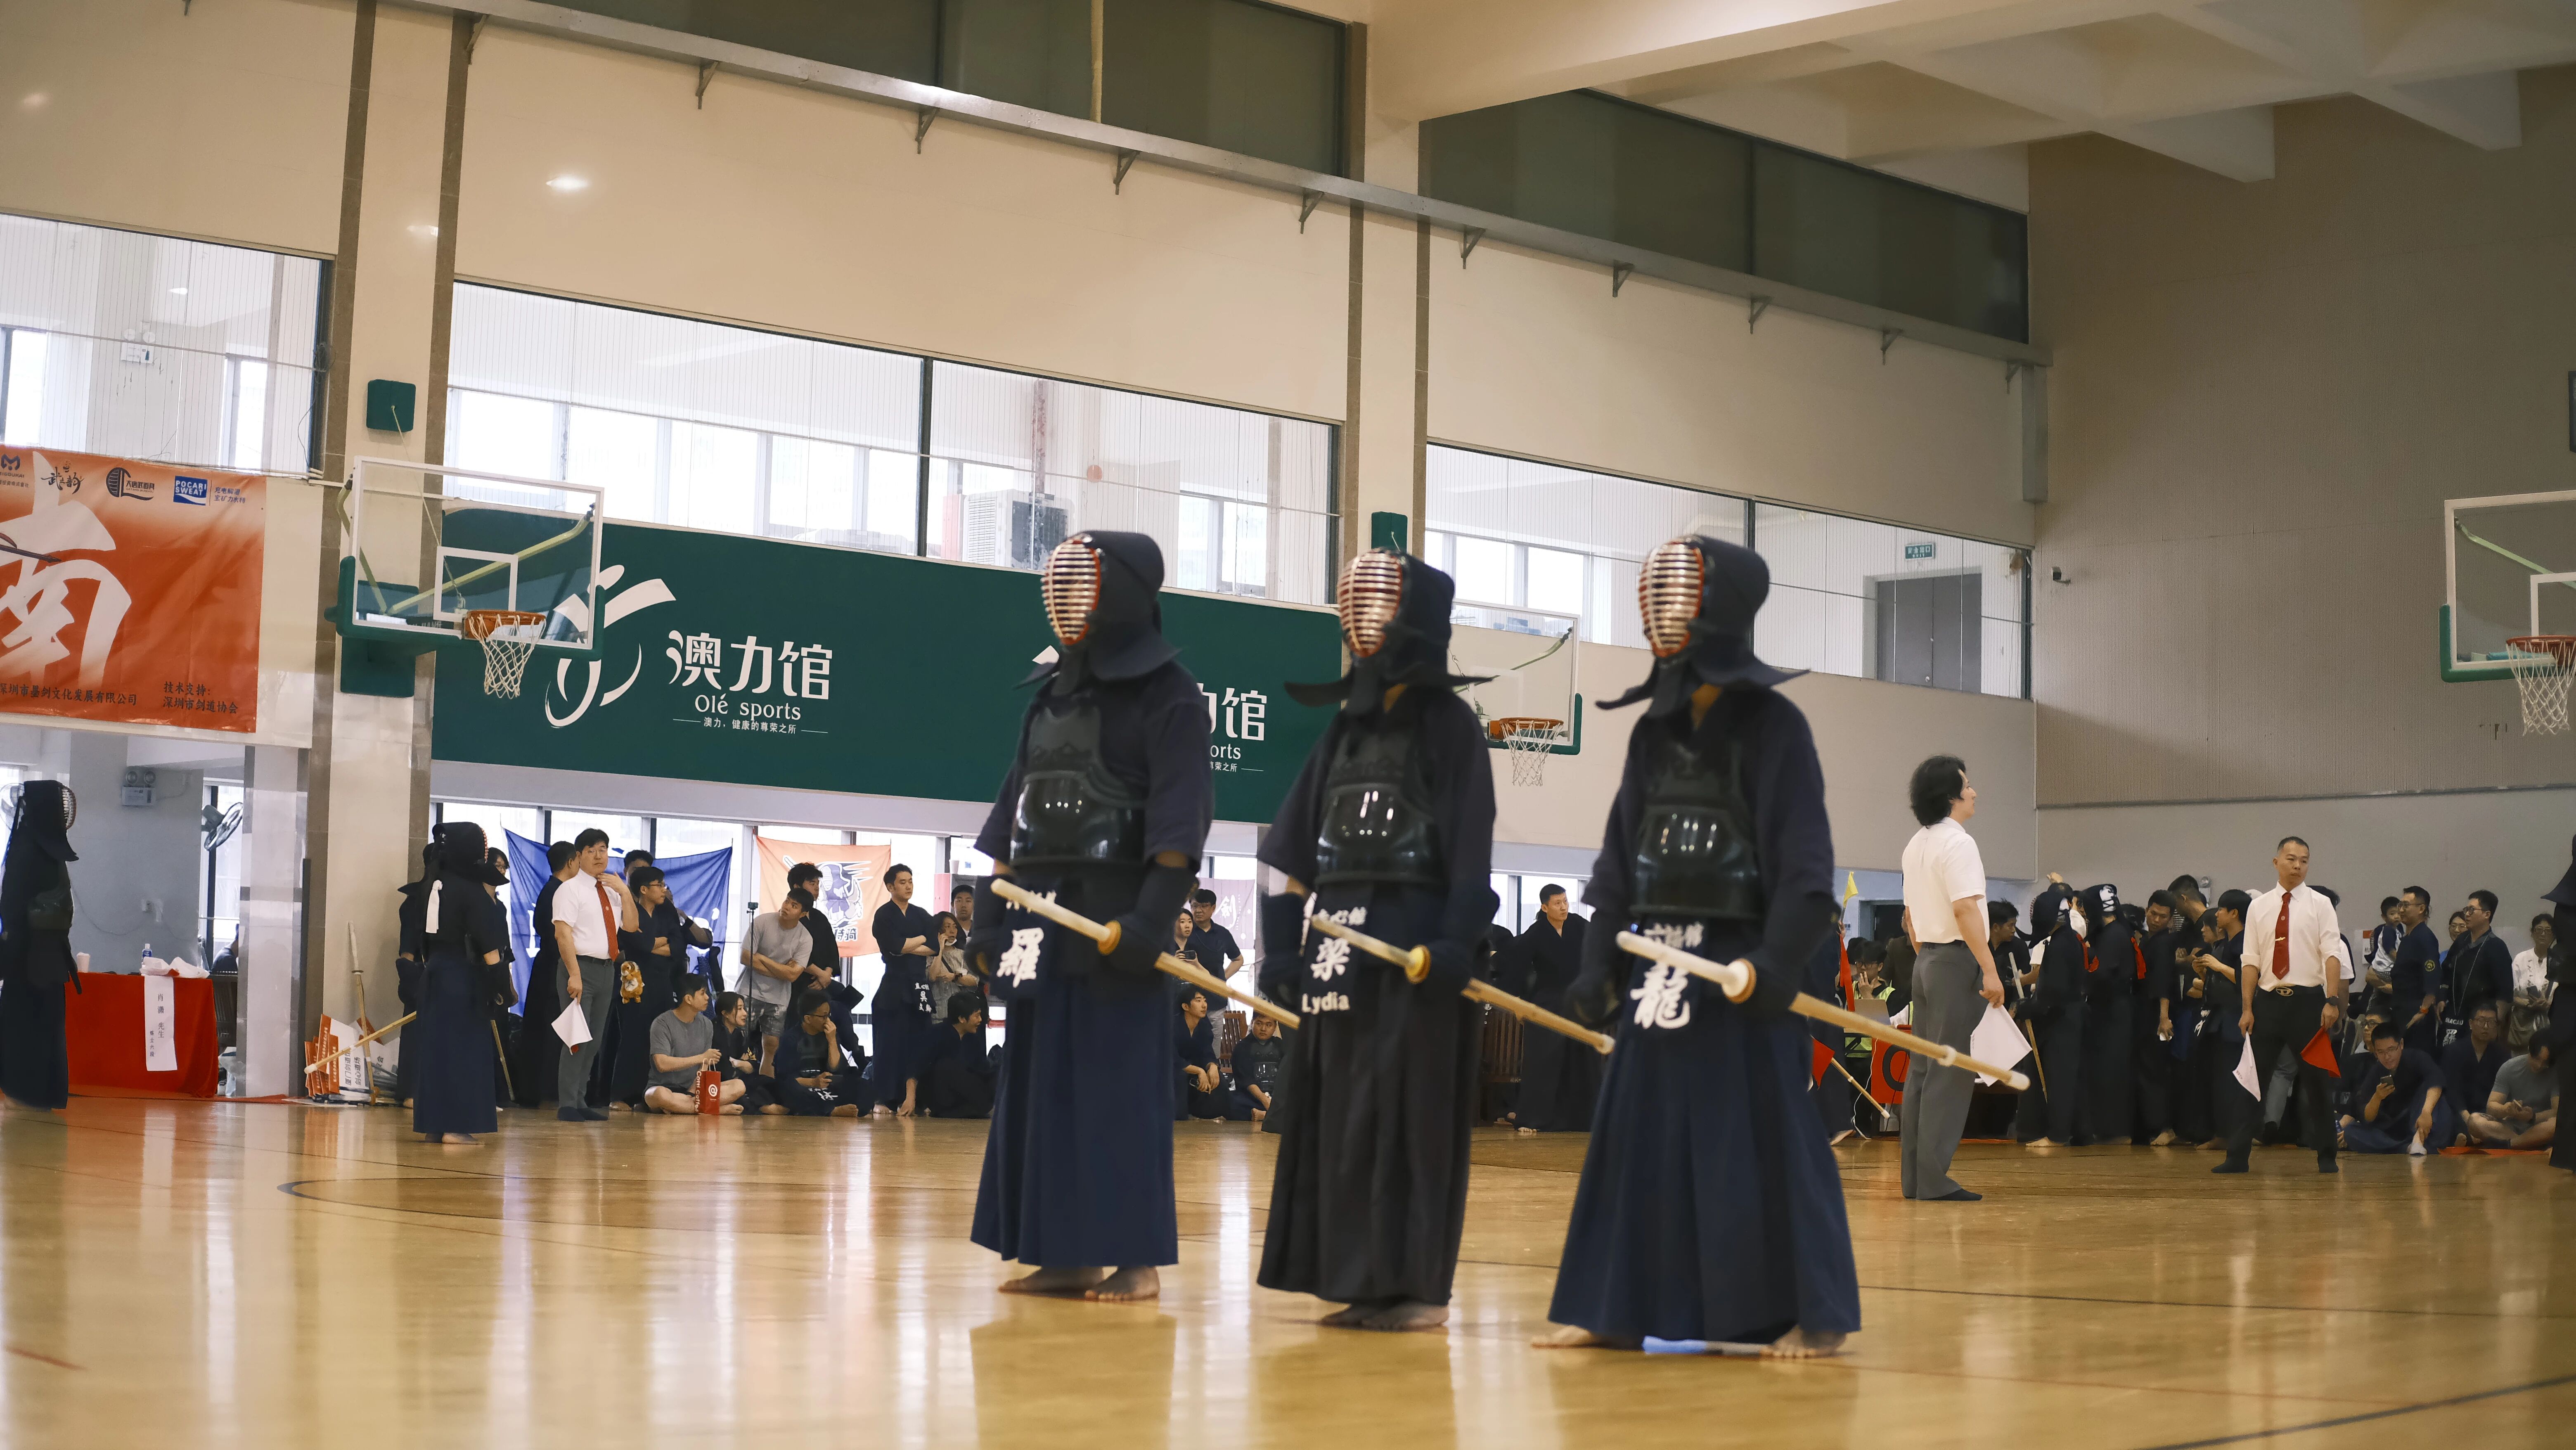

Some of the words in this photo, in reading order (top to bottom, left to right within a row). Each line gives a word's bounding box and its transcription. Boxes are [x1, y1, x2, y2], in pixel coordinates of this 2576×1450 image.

[175, 480, 206, 490] POCARI
[175, 486, 203, 495] SWEAT
[214, 495, 246, 504] 宝矿力水特
[665, 630, 832, 700] 澳力馆
[163, 696, 238, 714] 深圳市剑道协会
[695, 694, 728, 715] Olé
[739, 701, 801, 721] sports
[1301, 991, 1350, 1015] Lydia
